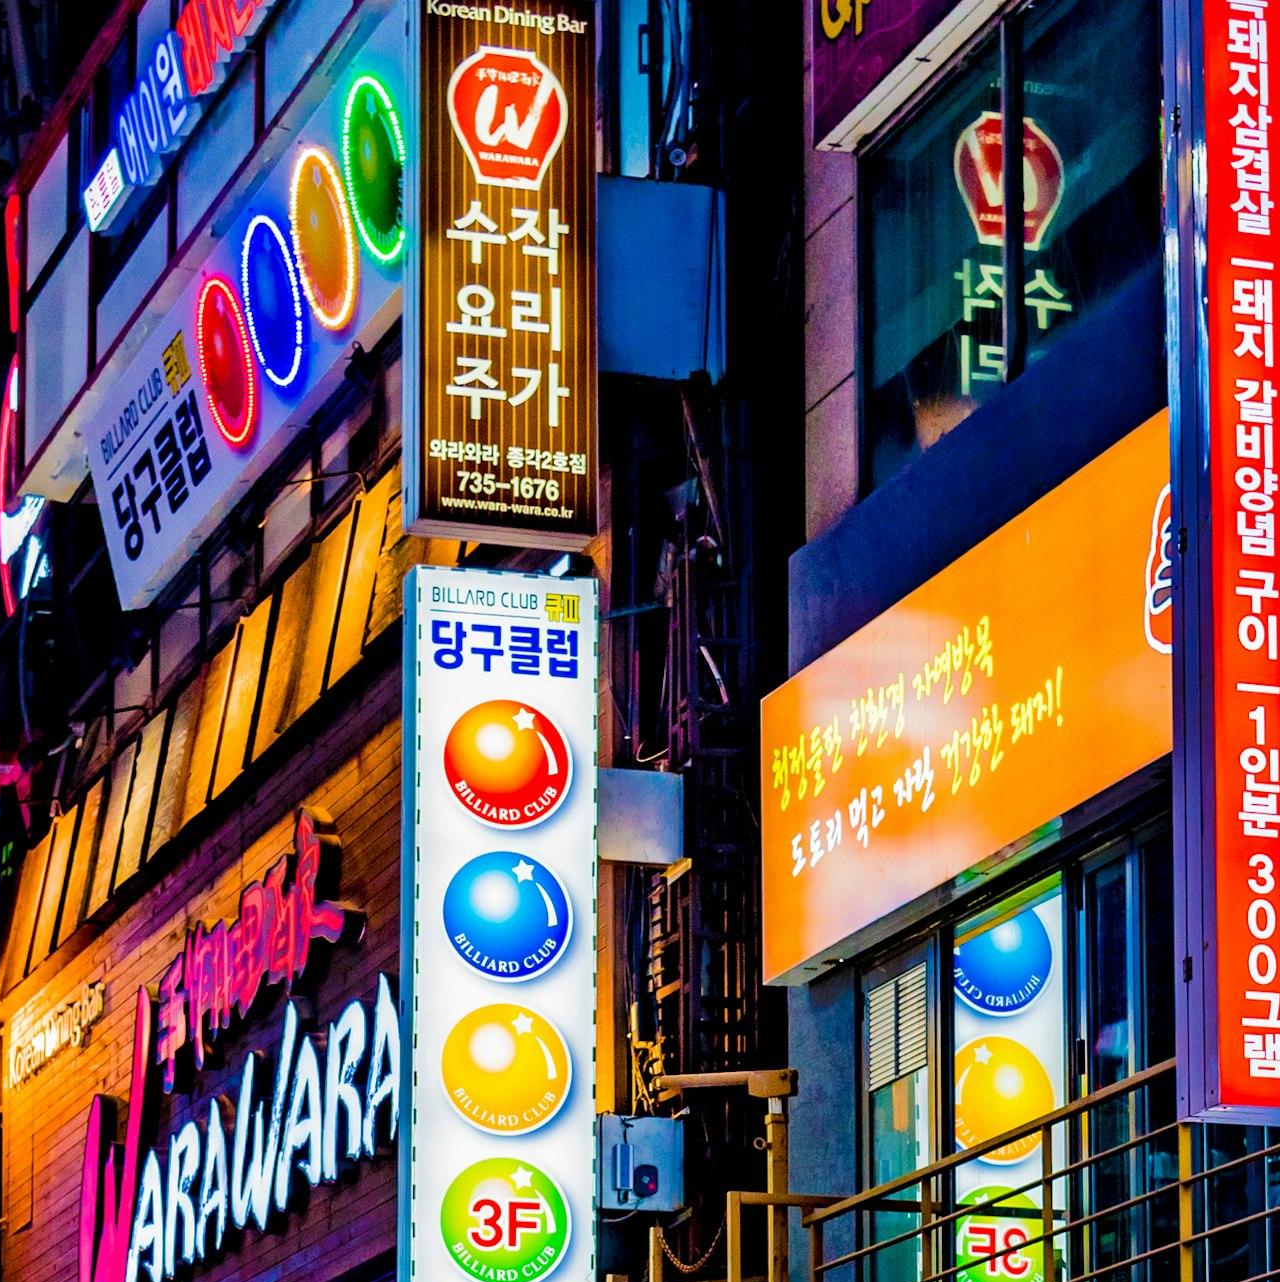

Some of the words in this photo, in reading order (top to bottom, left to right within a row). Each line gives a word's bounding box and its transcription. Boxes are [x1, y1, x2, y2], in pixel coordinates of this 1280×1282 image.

[426, 0, 493, 22] Korean
[494, 2, 555, 37] Dining
[557, 15, 588, 35] Bar
[479, 152, 539, 167] WARAWARA
[446, 201, 569, 275] 수작
[446, 284, 562, 352] 요리
[446, 358, 569, 427] 주가
[112, 392, 211, 562] 당구클럽
[429, 440, 500, 466] 와라와라
[507, 447, 587, 475] 종각2호점
[1233, 378, 1278, 559] 갈비양념
[441, 496, 573, 519] www.wara-wara.co.kr
[457, 471, 560, 502] 735-1676
[431, 586, 496, 607] BILLARD
[500, 592, 538, 610] CLUB
[1235, 569, 1280, 660] 구이
[431, 620, 580, 679] 당구클럽
[849, 672, 906, 754] 친환경
[912, 614, 994, 706] 자연방목
[790, 809, 843, 879] 도토리
[848, 785, 885, 848] 먹고
[893, 744, 936, 813] 자란
[939, 703, 1004, 797] 건강한
[1010, 666, 1064, 744] 돼지!
[454, 779, 520, 822] BILLIARD
[522, 785, 559, 821] CLUB
[454, 931, 520, 974] BILLIARD
[522, 937, 558, 971] CLUB
[9, 1034, 48, 1089] Korean
[80, 981, 106, 1027] Bar
[453, 1085, 519, 1128] BILLIARD
[521, 1090, 557, 1124] CLUB
[470, 1198, 542, 1249] 3F
[451, 1243, 518, 1282] BILLIARD
[521, 1244, 557, 1281] CLUB
